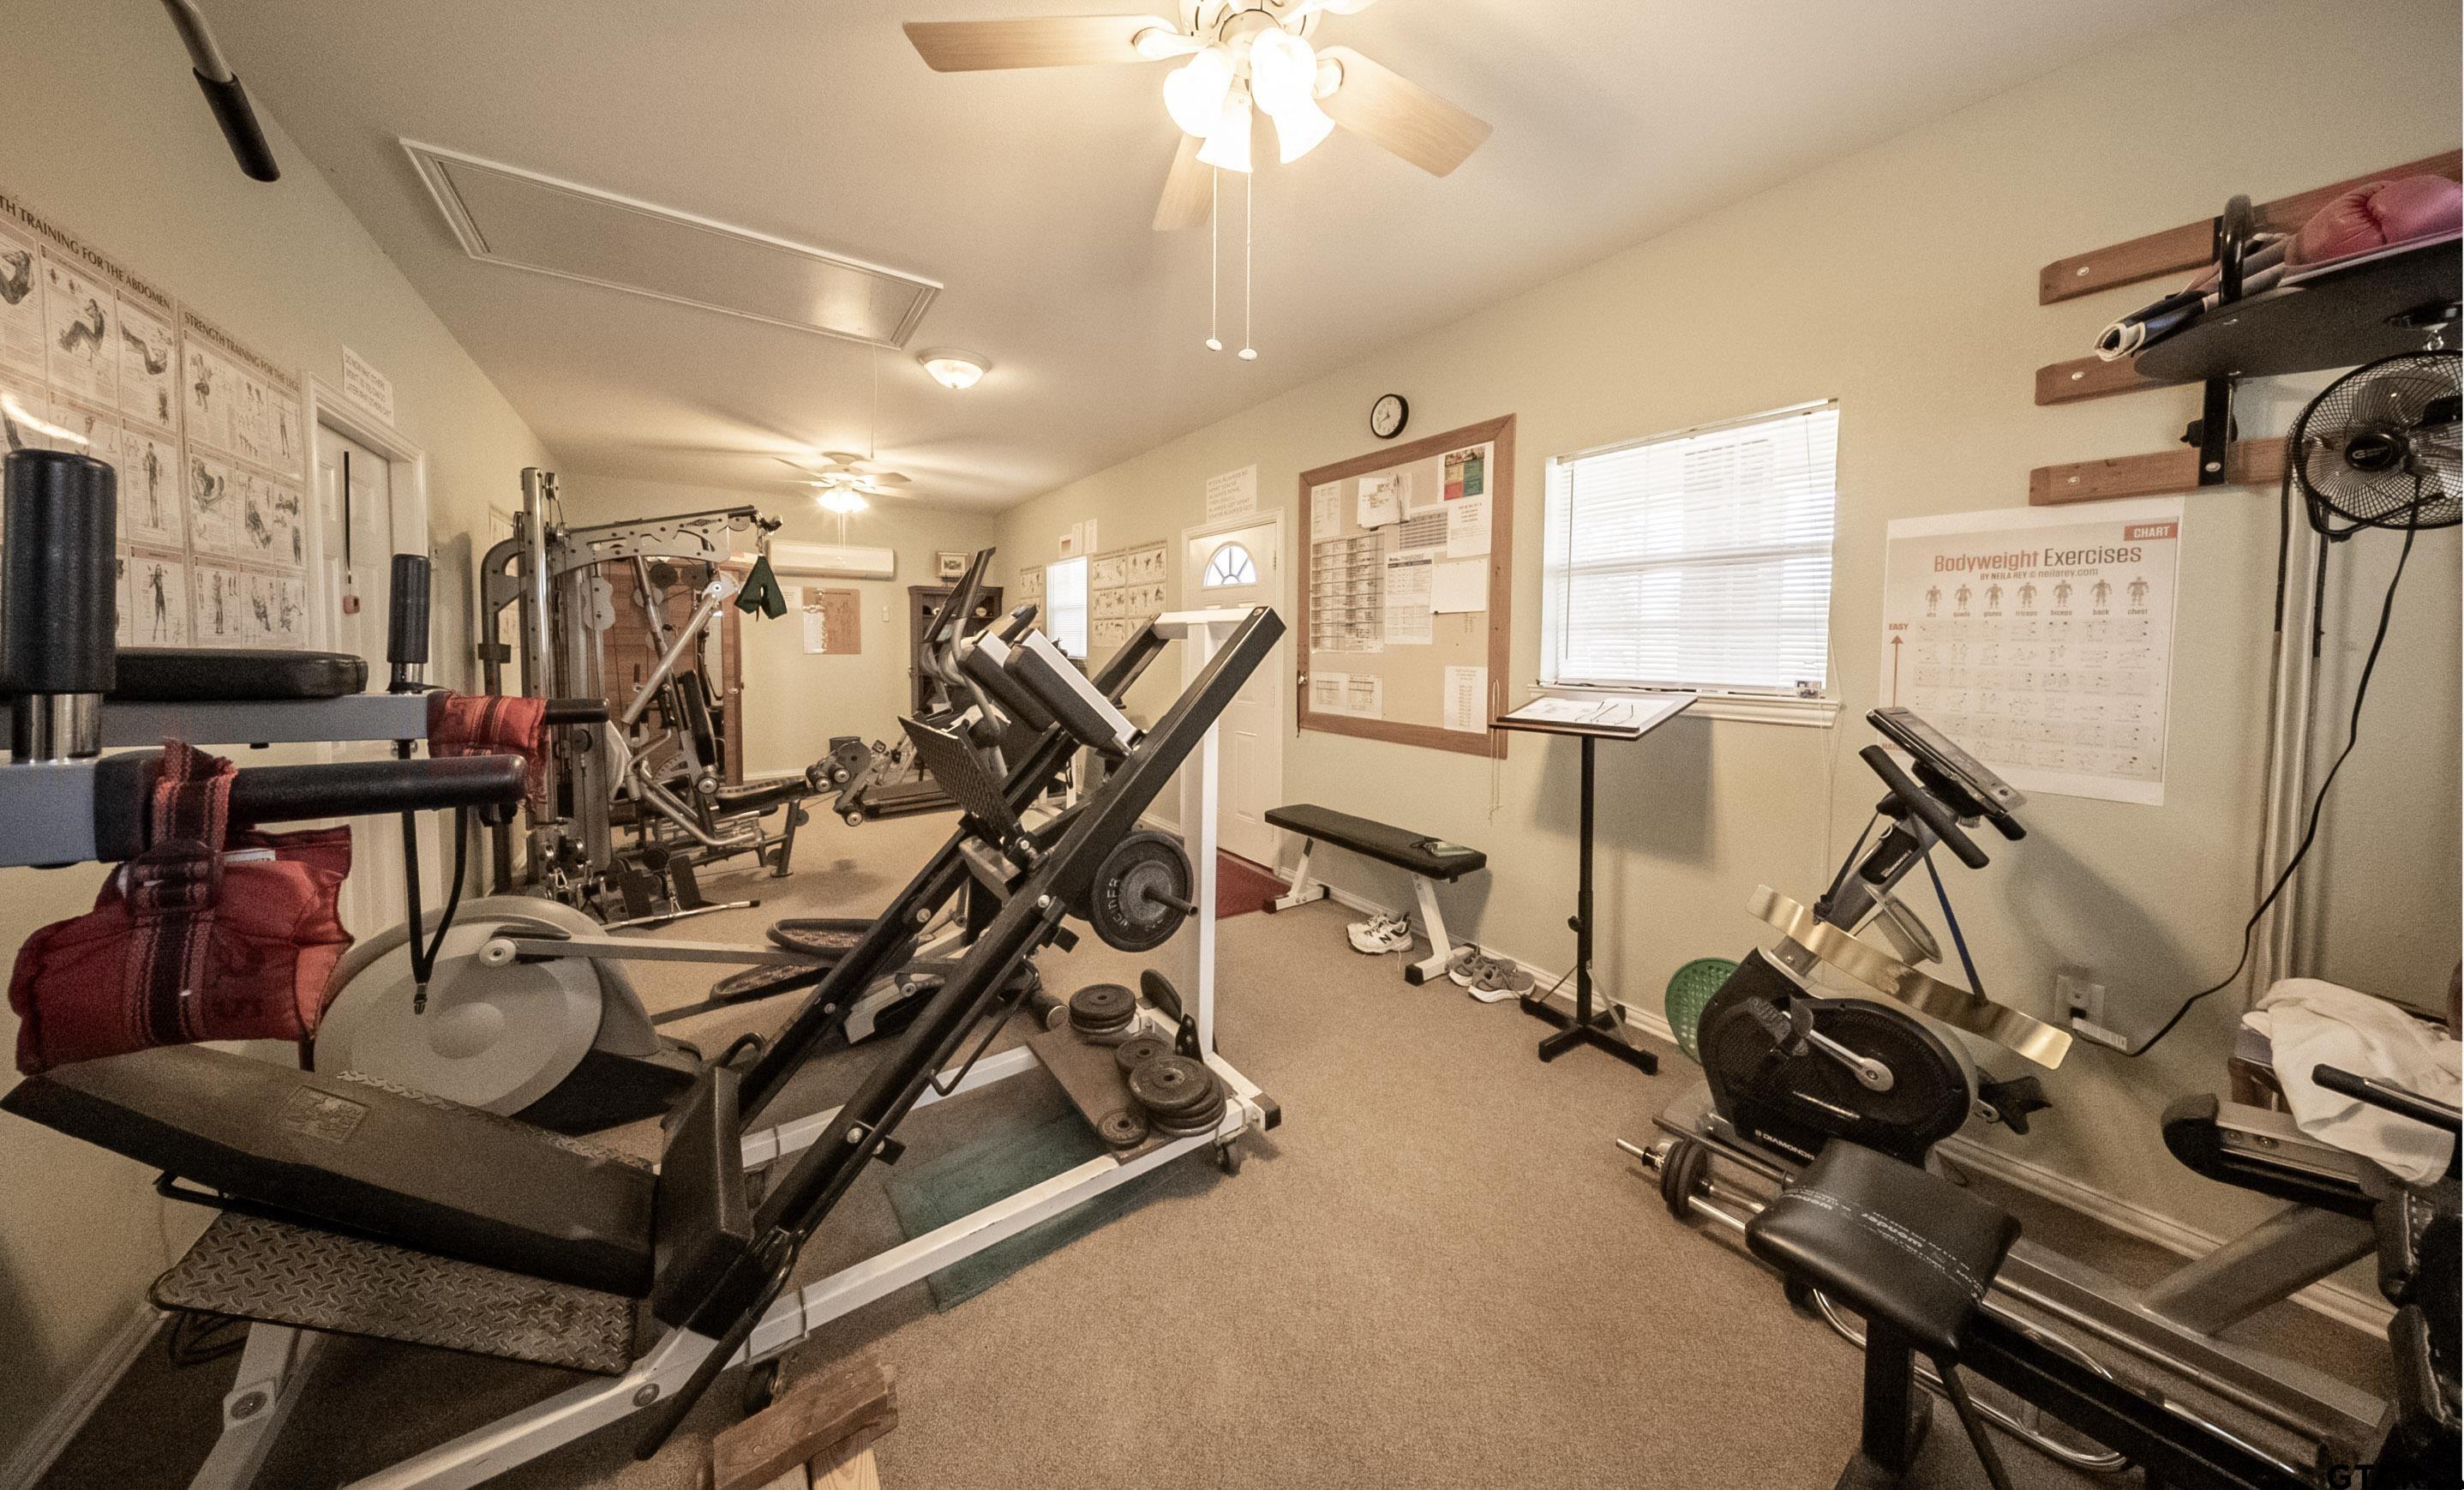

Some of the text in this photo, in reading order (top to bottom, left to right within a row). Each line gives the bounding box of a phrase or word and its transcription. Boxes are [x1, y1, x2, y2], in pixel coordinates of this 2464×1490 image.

[19, 207, 79, 255] TRAINING
[82, 247, 104, 269] FOR
[104, 260, 124, 282] THE
[125, 275, 171, 309] ABDOMEN
[184, 312, 225, 346] STRENGTH
[2134, 526, 2170, 538] CHART
[1934, 545, 2142, 573] Bodyweight Exercises
[2038, 568, 2099, 579] neilarey.com
[1889, 622, 1909, 631] EASY
